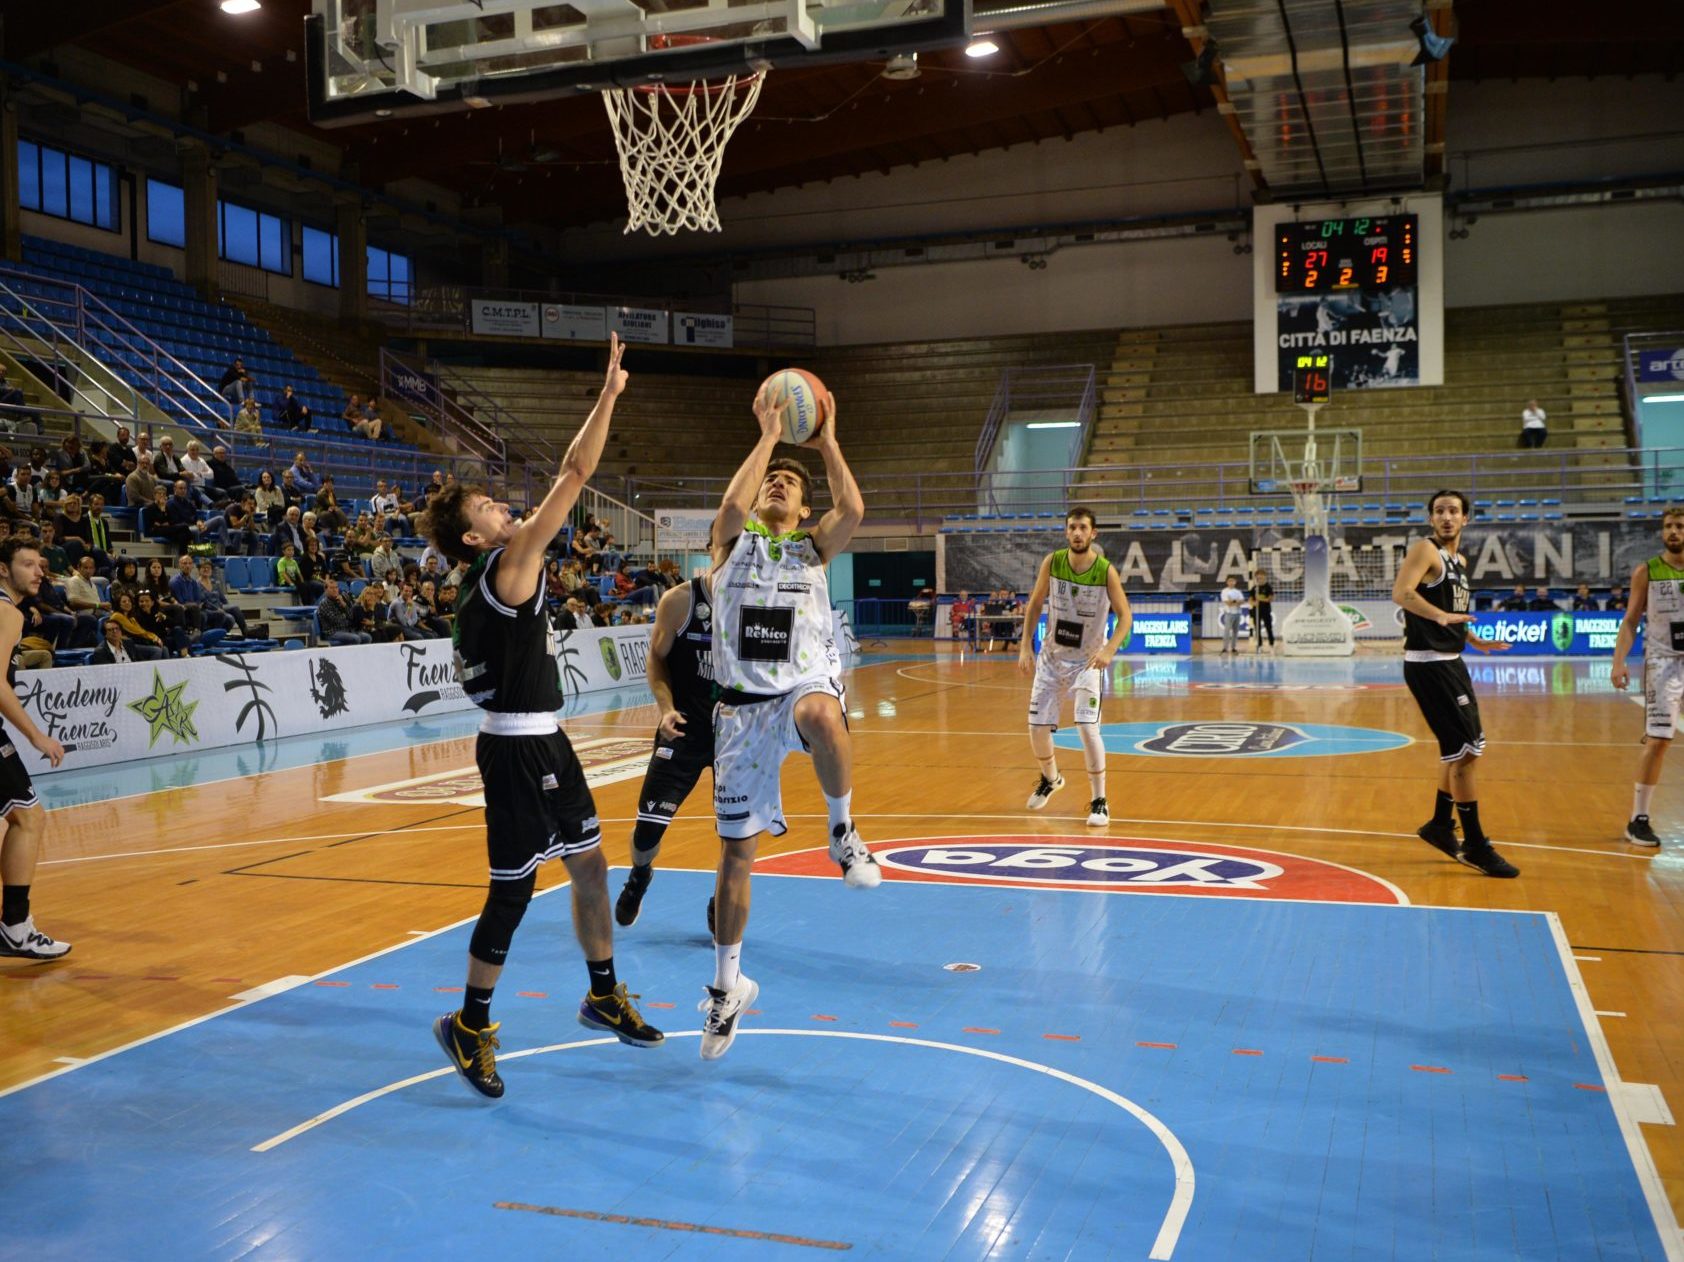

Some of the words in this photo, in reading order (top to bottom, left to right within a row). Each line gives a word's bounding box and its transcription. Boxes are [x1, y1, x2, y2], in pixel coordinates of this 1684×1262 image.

[1321, 221, 1344, 238] 04
[1354, 219, 1370, 235] 12
[1305, 251, 1328, 268] 27
[1371, 247, 1388, 264] 19
[1305, 270, 1318, 288] 2
[1340, 268, 1353, 285] 2
[1376, 266, 1388, 283] 3
[1329, 330, 1347, 346] DI
[1350, 327, 1417, 344] FAENZA
[1305, 372, 1327, 391] 16
[42, 711, 118, 743] Faenza
[920, 849, 1225, 884] Yoga
